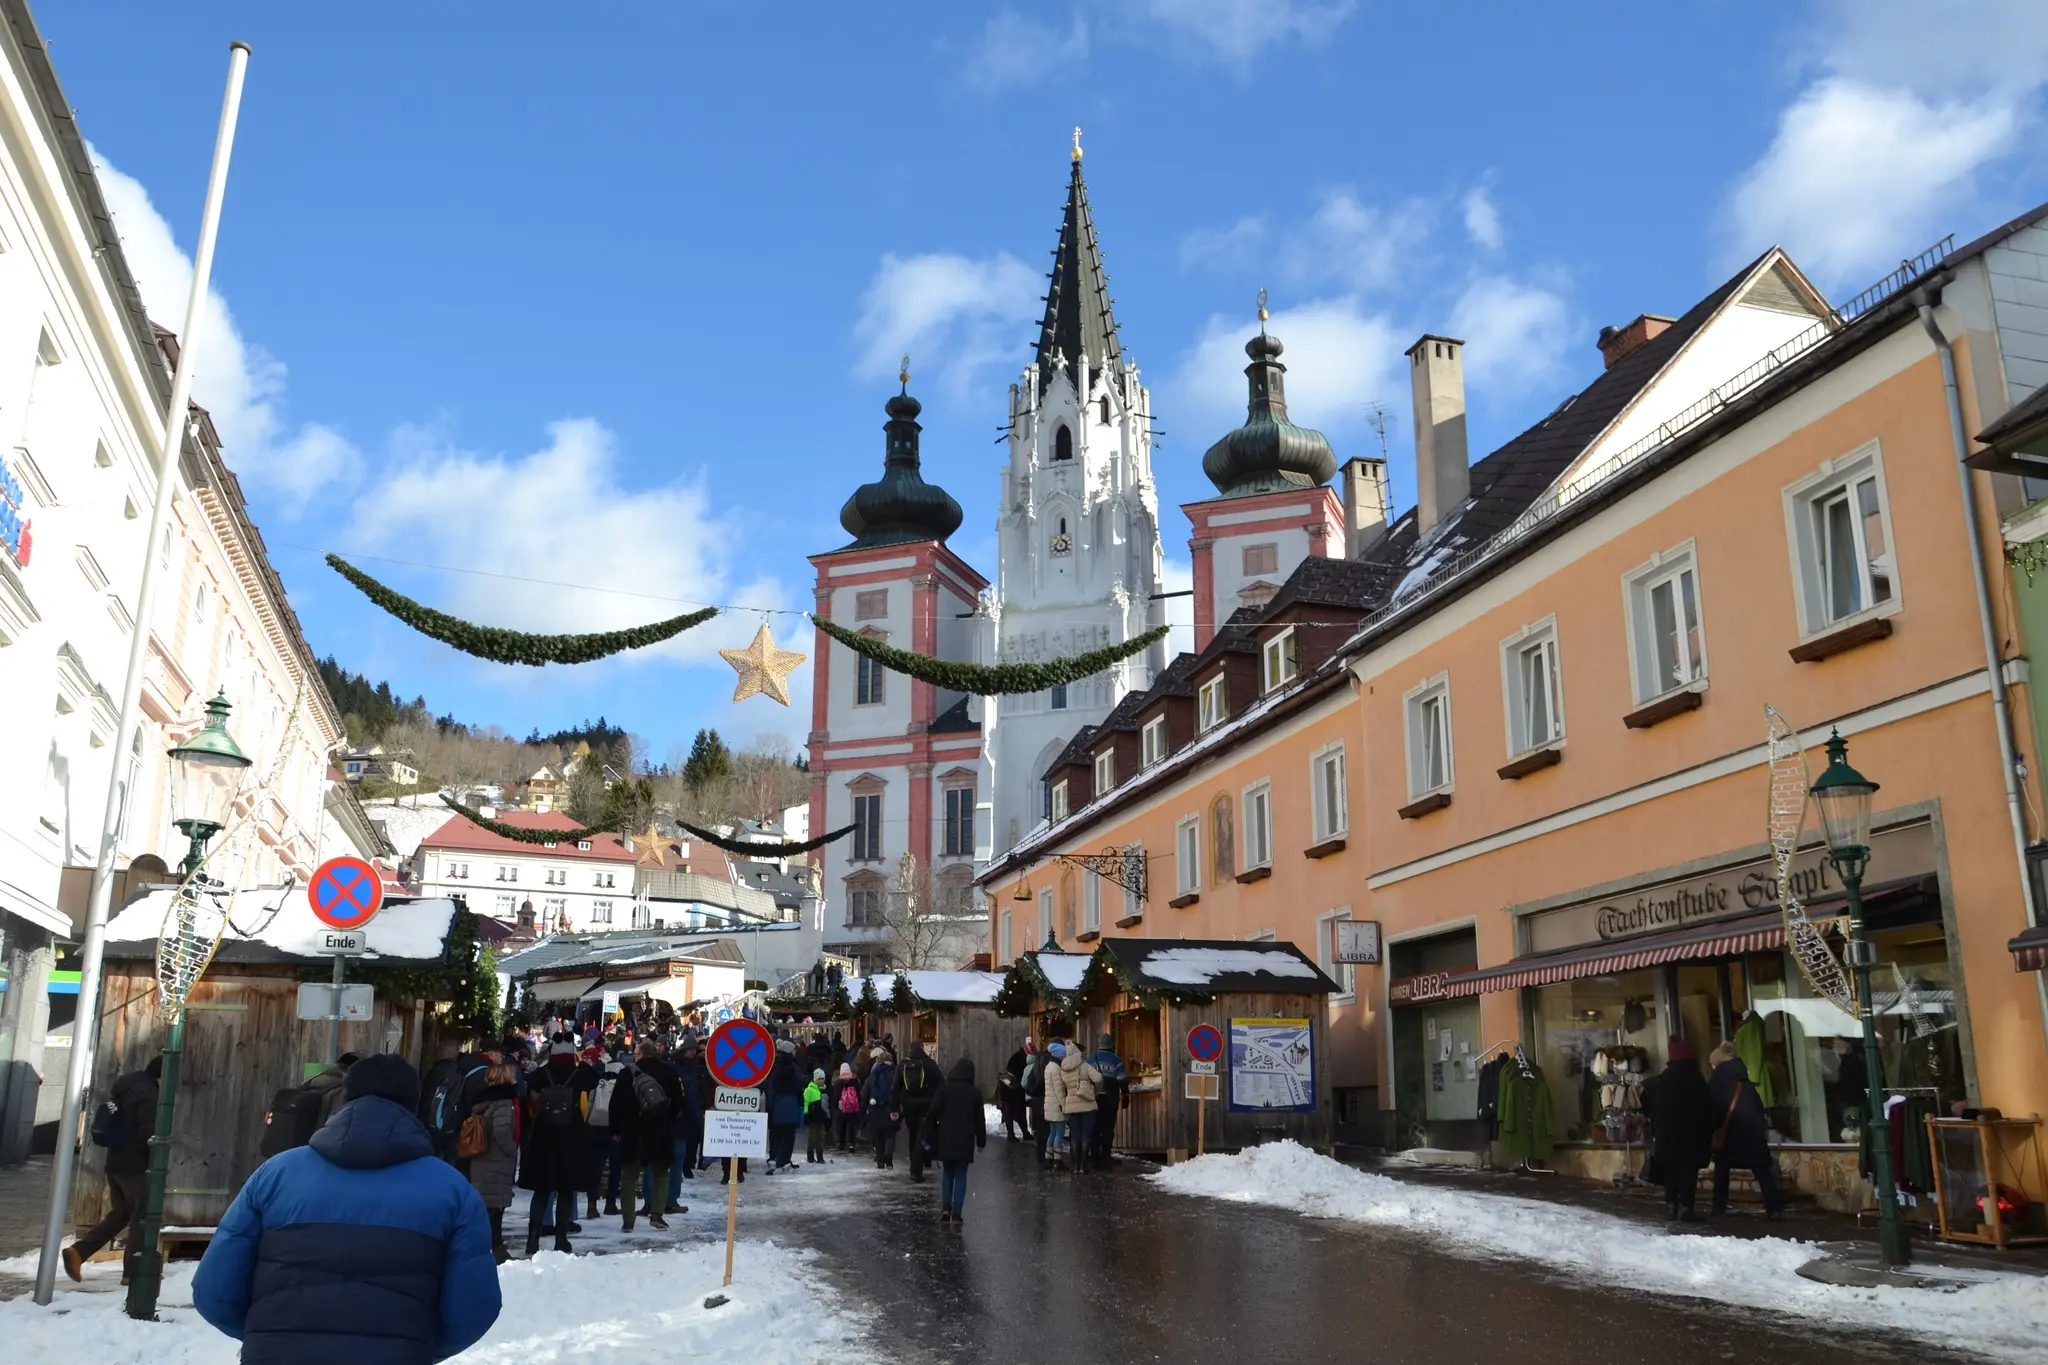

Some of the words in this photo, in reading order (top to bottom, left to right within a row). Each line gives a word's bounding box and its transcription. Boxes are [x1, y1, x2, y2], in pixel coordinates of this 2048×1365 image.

[325, 934, 356, 949] Ende
[1339, 953, 1376, 961] LIBRA
[672, 965, 693, 973] KERZEN
[1390, 984, 1411, 999] UHREN
[1411, 971, 1449, 1000] LIBRA
[1195, 1062, 1212, 1071] Ende
[718, 1092, 758, 1108] Anfang
